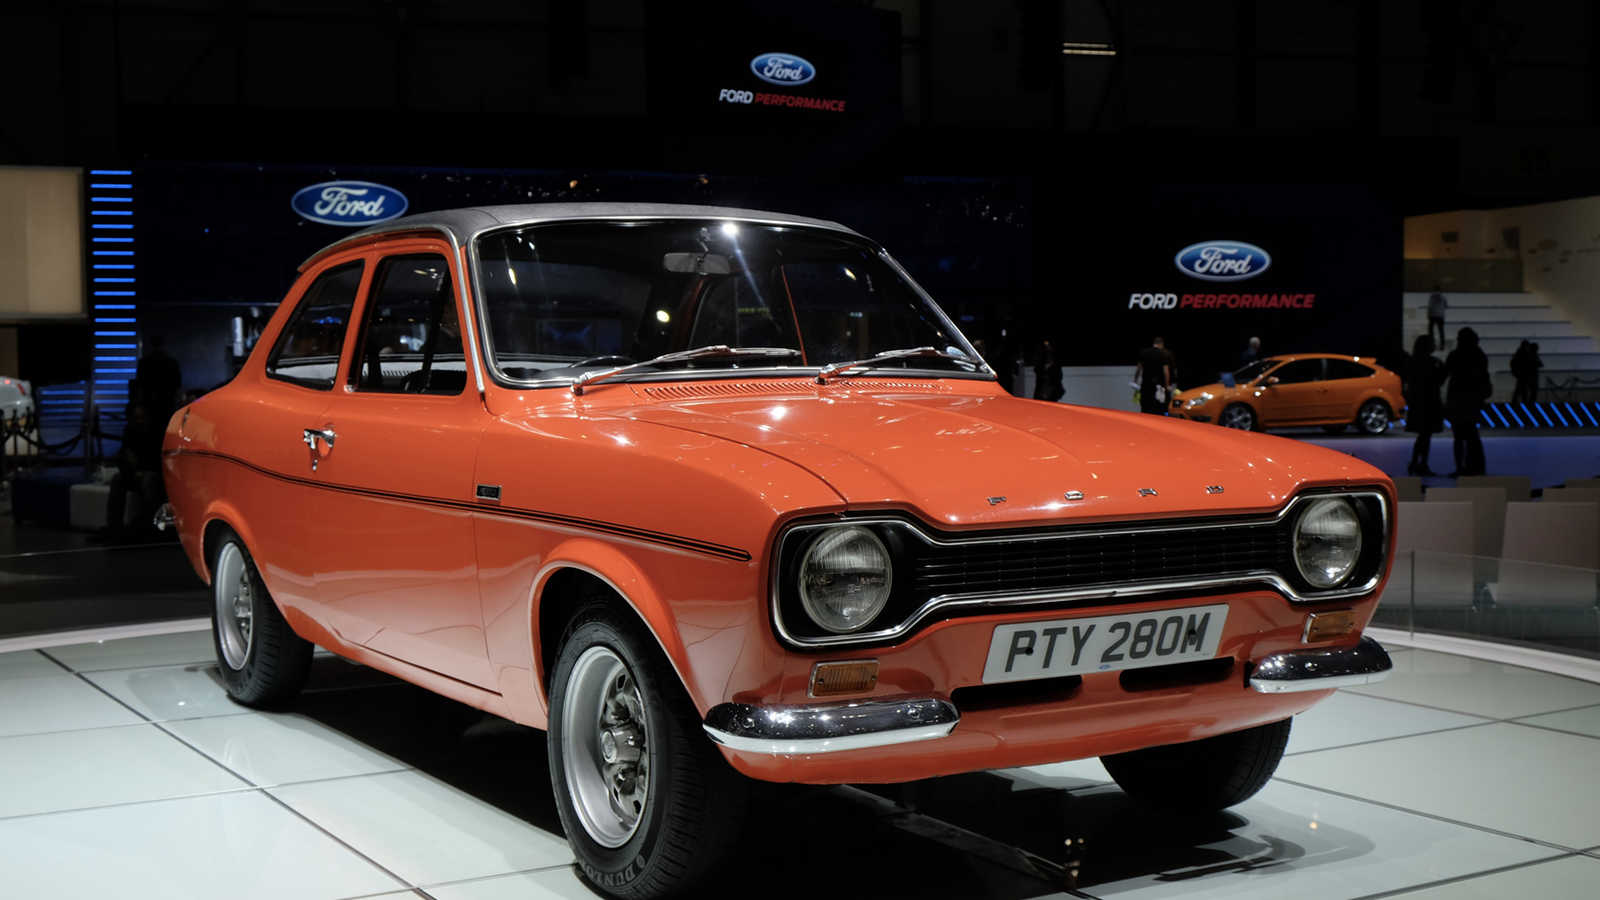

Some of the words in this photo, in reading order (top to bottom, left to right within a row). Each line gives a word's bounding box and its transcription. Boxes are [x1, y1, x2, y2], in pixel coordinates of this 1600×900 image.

[763, 56, 803, 81] Ford
[719, 88, 754, 104] FORD
[755, 92, 846, 112] PERFORMANCE
[314, 186, 386, 217] Ford
[1193, 246, 1253, 274] Ford
[1128, 293, 1178, 310] FORD
[1180, 293, 1316, 309] PERFORMANCE
[1004, 624, 1097, 673] PTY
[1100, 612, 1212, 663] 280M
